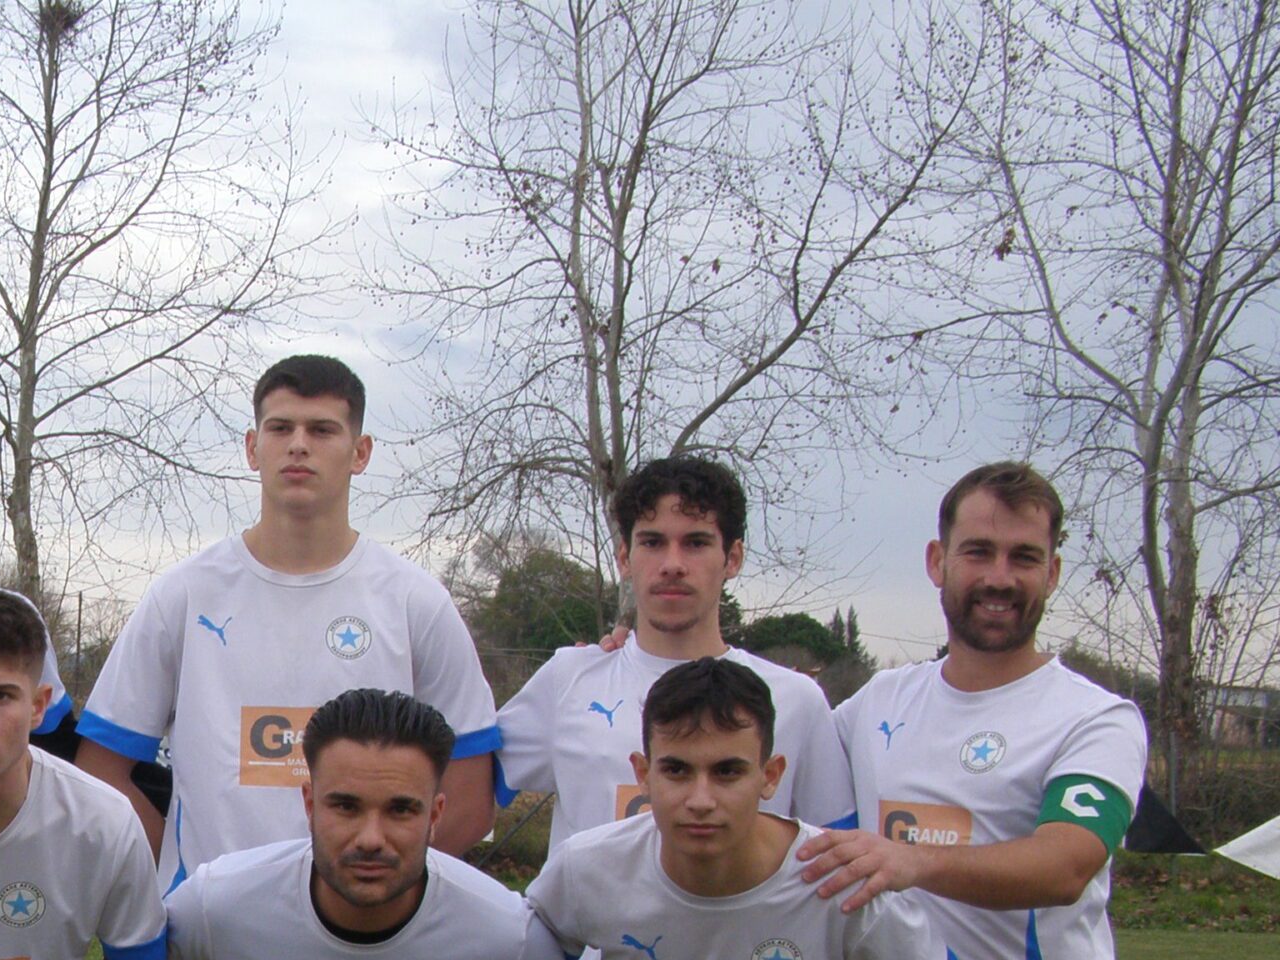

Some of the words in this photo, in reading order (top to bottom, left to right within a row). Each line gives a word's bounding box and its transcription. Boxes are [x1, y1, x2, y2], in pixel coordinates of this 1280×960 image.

[249, 714, 306, 758] GRA
[1060, 782, 1106, 818] C
[883, 809, 959, 847] GRAND
